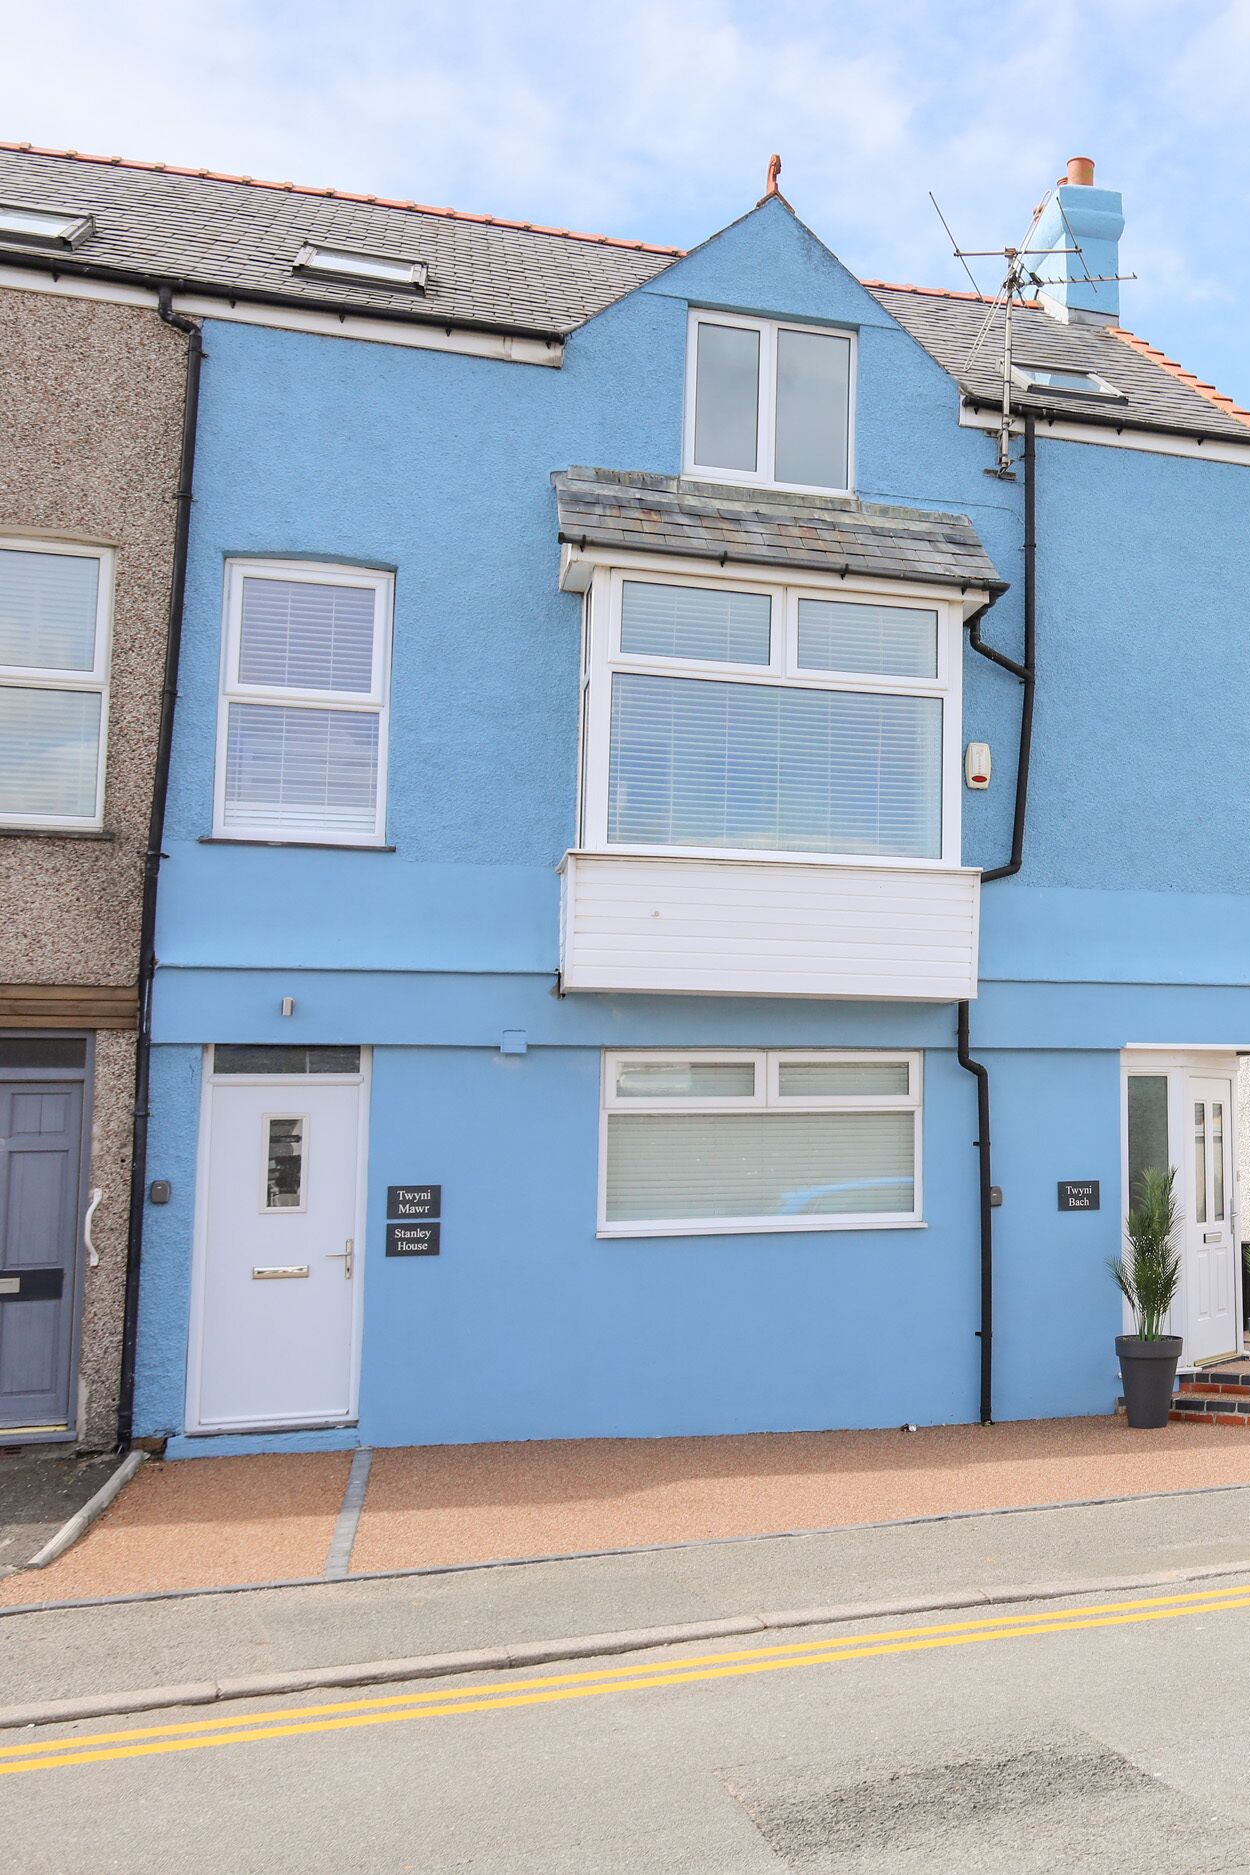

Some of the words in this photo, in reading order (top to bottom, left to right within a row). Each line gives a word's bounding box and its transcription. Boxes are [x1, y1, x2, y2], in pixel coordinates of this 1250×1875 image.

[1065, 1185, 1092, 1196] Twyni
[397, 1190, 431, 1202] Twyni
[1069, 1197, 1090, 1206] Bach
[398, 1204, 430, 1214] Mawr
[394, 1228, 432, 1240] Stanley
[397, 1241, 428, 1251] House
